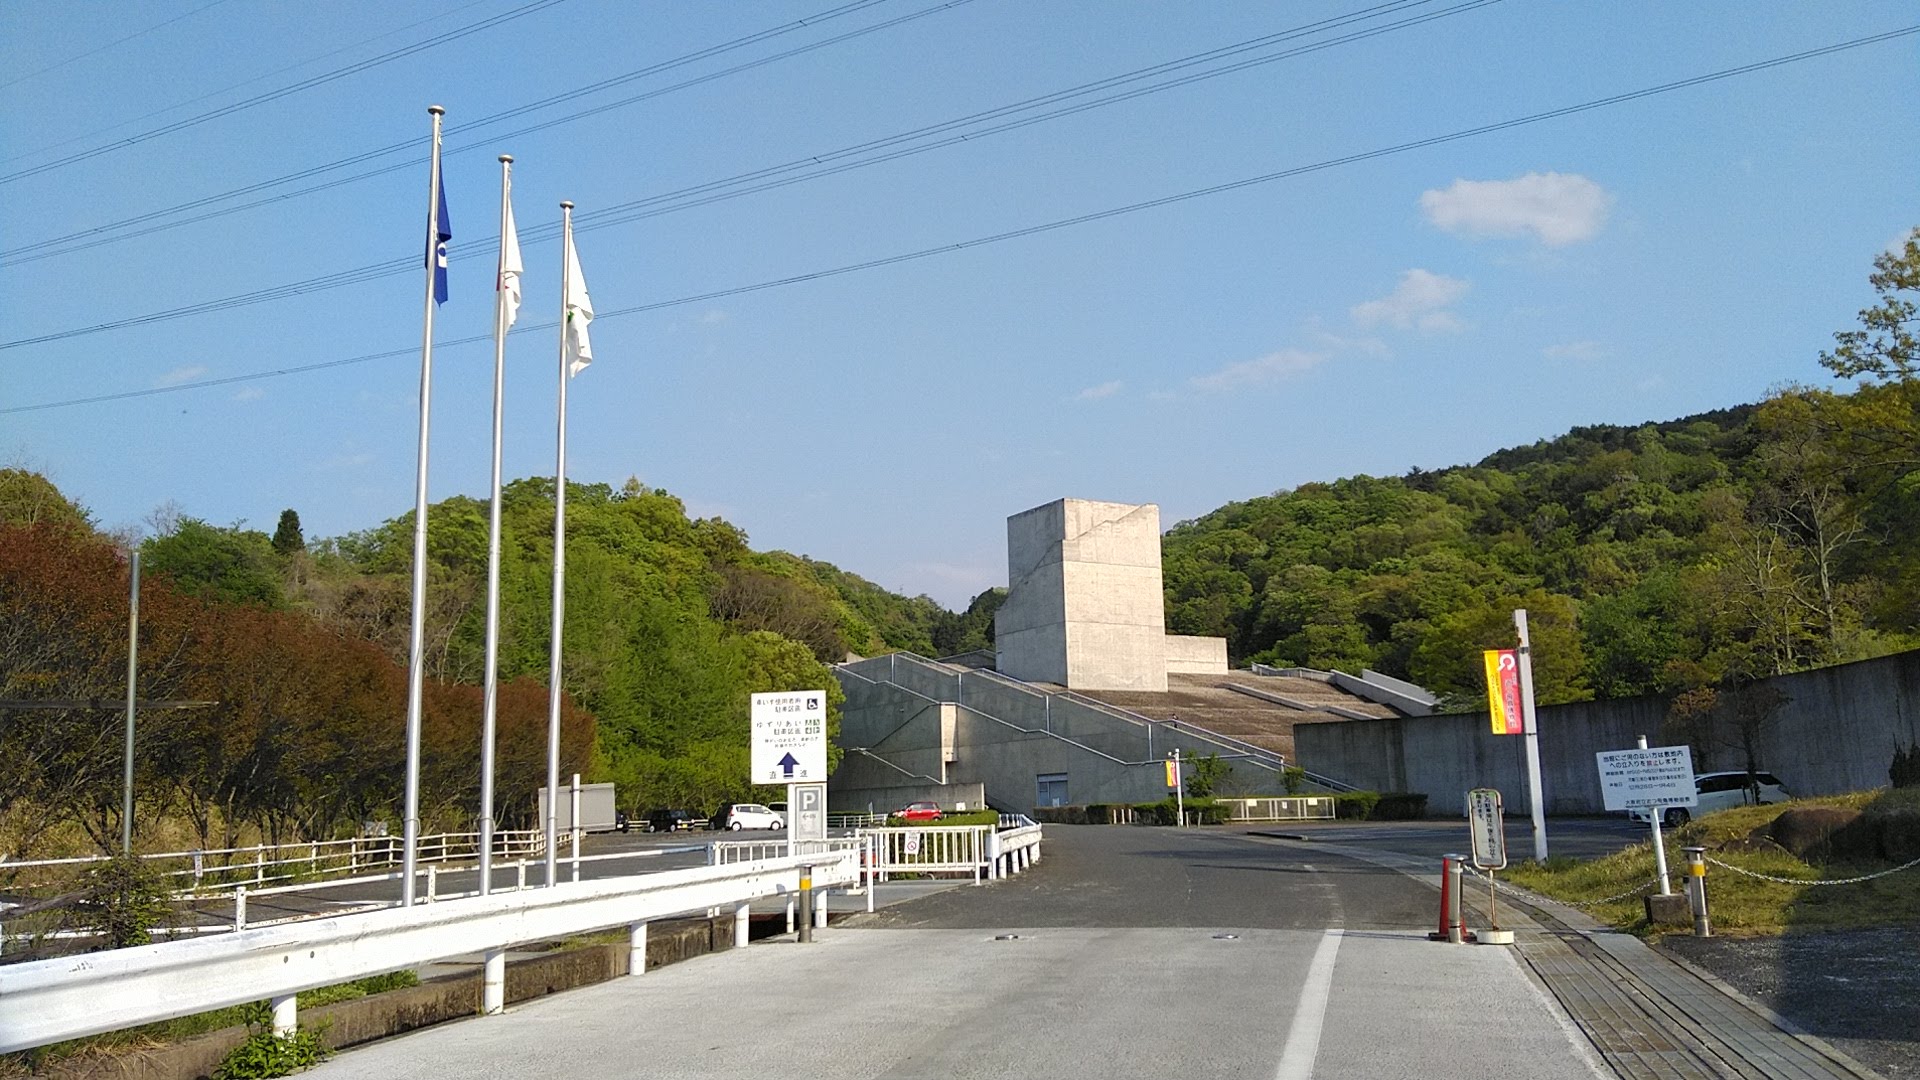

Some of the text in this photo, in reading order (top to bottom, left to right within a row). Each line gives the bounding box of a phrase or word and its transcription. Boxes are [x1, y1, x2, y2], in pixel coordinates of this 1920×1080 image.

[1609, 758, 1681, 769] への立入りを禁止します。
[803, 792, 815, 809] P
